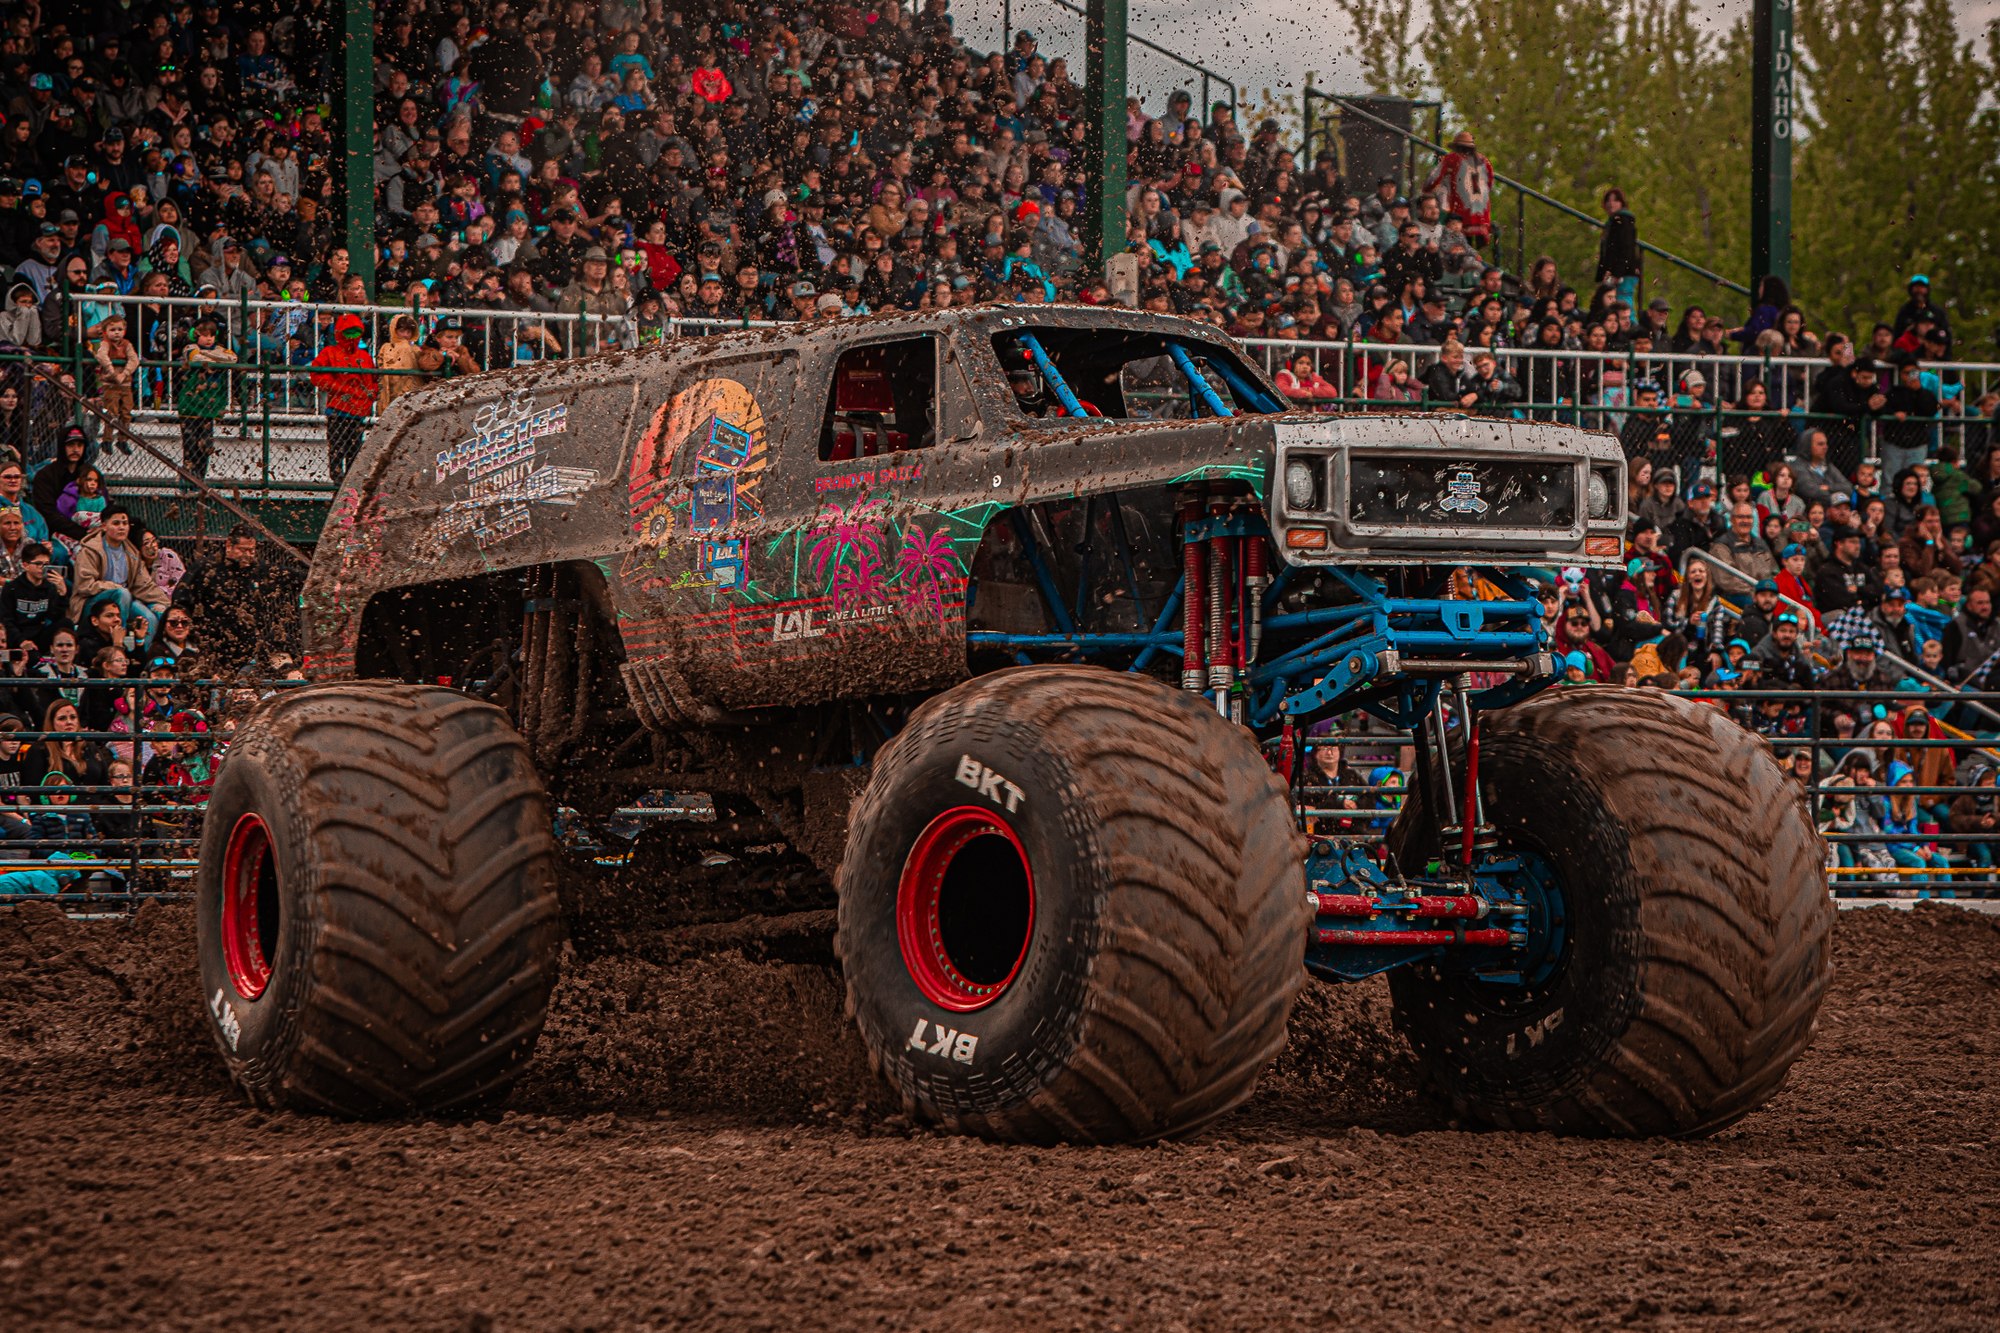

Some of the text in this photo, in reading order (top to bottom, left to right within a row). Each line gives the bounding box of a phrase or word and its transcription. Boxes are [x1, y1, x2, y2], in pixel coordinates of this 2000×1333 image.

[1774, 29, 1791, 139] IDAHO
[435, 403, 568, 484] MONSTER
[467, 436, 536, 480] TRUCK
[815, 470, 875, 493] BRANDON
[715, 546, 737, 560] LAL
[773, 608, 827, 641] LAL
[827, 610, 850, 622] LIVE
[851, 609, 859, 619] A
[954, 753, 1026, 814] BKT
[210, 987, 242, 1053] BKT
[906, 1017, 979, 1067] BKT
